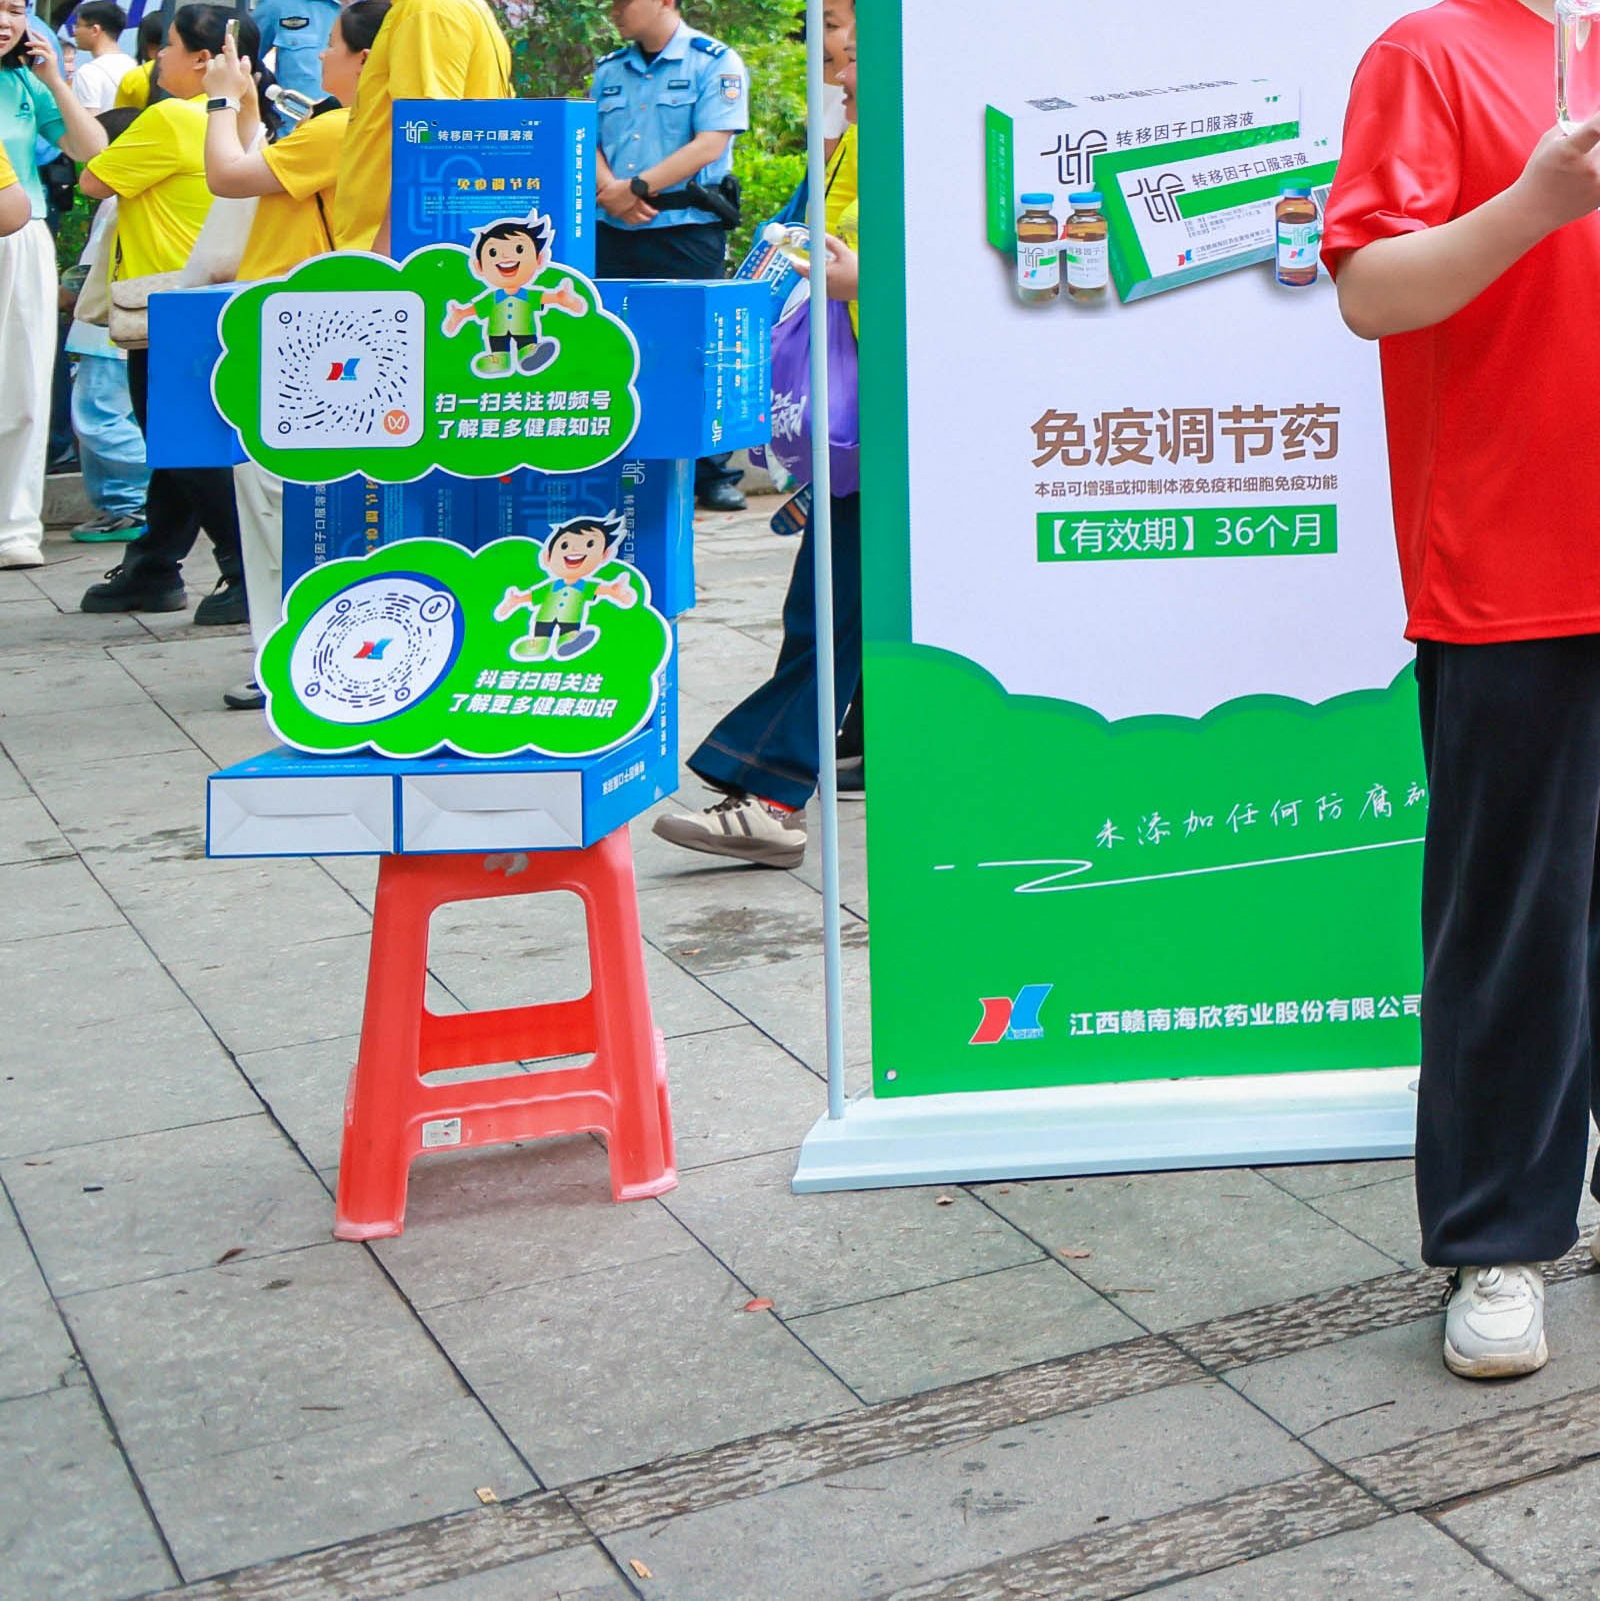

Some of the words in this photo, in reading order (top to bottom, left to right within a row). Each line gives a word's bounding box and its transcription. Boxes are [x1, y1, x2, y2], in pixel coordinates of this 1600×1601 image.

[437, 129, 534, 142] 转移因子口服溶液
[1116, 111, 1255, 148] 转移因子口服溶液
[1191, 151, 1309, 188] 转移因子口服溶液
[434, 391, 612, 413] 扫一扫关注视频号
[436, 415, 611, 440] 了解更多健康知识
[1030, 402, 1341, 469] 免疫调节药
[1034, 474, 1338, 499] 本品可增强或抑制体液免疫和细胞免疫功能
[474, 670, 605, 694] 抖音扫码关注
[448, 693, 619, 719] 了解更多健康知识
[1069, 993, 1422, 1037] 江西赣南海欣药业股份有限公司
